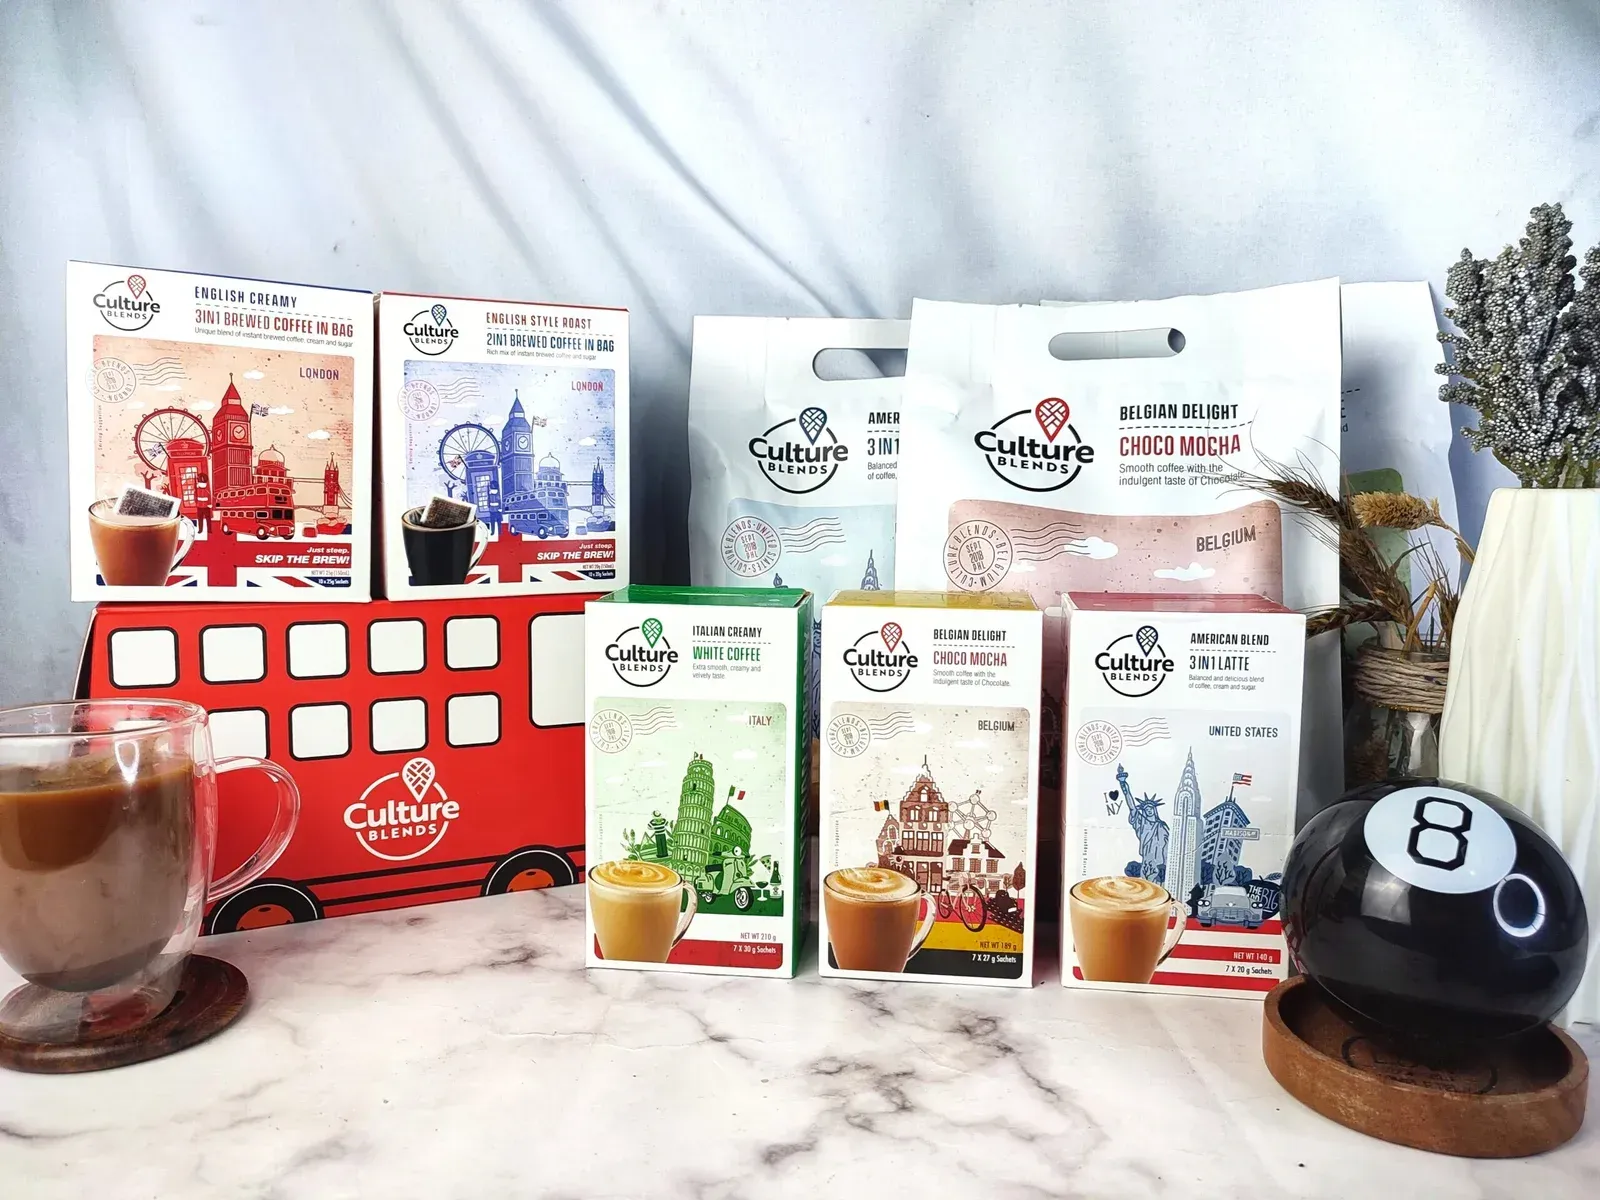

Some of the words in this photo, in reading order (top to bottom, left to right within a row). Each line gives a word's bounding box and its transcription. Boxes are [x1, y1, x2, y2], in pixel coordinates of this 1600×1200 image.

[93, 293, 160, 314] Culture
[195, 286, 244, 303] ENGLISH
[250, 292, 297, 308] CREAMY
[106, 310, 148, 320] BLENDS
[486, 312, 526, 326] ENGLISH
[531, 315, 558, 328] STYLE
[563, 317, 592, 329] ROAST
[196, 309, 220, 324] 3IN1
[224, 312, 270, 330] BREWED
[274, 316, 312, 334] COFFEE
[316, 321, 328, 336] IN
[332, 323, 354, 338] BAG
[403, 322, 459, 338] Culture
[194, 327, 216, 336] Unique
[217, 328, 234, 336] blend
[264, 333, 285, 342] brewed
[415, 337, 448, 346] BLENDS
[486, 332, 507, 346] 2IN1
[510, 334, 547, 349] BREWED
[550, 336, 581, 350] COFFEE
[585, 338, 594, 351] IN
[597, 339, 614, 352] BAG
[300, 367, 339, 380] LONDON
[572, 380, 604, 392] LONDON
[1120, 404, 1178, 420] BELGIAN
[1182, 404, 1238, 420] DELIGHT
[749, 437, 848, 463] Culture
[974, 430, 1095, 464] Culture
[1120, 435, 1174, 456] CHOCO
[1180, 434, 1241, 456] MOCHA
[768, 463, 828, 475] BLENDS
[868, 461, 898, 470] Balanced
[997, 456, 1070, 475] BLENDS
[1119, 463, 1155, 473] Smooth
[1157, 463, 1184, 473] coffee
[1187, 463, 1206, 473] with
[1208, 463, 1224, 473] the
[868, 472, 874, 480] of
[875, 471, 897, 480] coffee,
[1119, 476, 1162, 487] indulgent
[1164, 476, 1188, 486] taste
[1189, 476, 1198, 486] of
[953, 524, 996, 543] BLENDS
[1196, 525, 1257, 553] BELGIUM
[966, 541, 981, 554] SEPT
[255, 554, 283, 564] SKIP
[286, 555, 310, 564] THE
[312, 556, 350, 564] BREW!
[537, 551, 560, 560] SKIP
[562, 551, 581, 560] THE
[584, 551, 614, 559] BREW!
[969, 550, 984, 564] 2018
[693, 625, 725, 637] ITALIAN
[728, 626, 762, 638] CREAMY
[933, 629, 969, 640] BELGIAN
[972, 630, 1006, 641] DELIGHT
[1190, 633, 1238, 645] AMERICAN
[1241, 634, 1269, 646] BLEND
[605, 643, 678, 663] Culture
[693, 646, 724, 660] WHITE
[727, 647, 761, 661] COFFEE
[843, 648, 918, 668] Culture
[933, 651, 967, 666] CHOCO
[970, 652, 1007, 666] MOCHA
[620, 664, 663, 672] BLENDS
[1095, 652, 1175, 673] Culture
[1219, 656, 1250, 671] LATTE
[858, 668, 903, 677] BLENDS
[1111, 673, 1158, 682] BLENDS
[933, 678, 959, 686] indulgent
[749, 715, 772, 726] ITALY
[978, 720, 1015, 731] BELGIUM
[1209, 725, 1241, 737] UNITED
[1244, 727, 1278, 738] STATES
[1103, 792, 1108, 803] I
[343, 800, 460, 829] Culture
[1106, 800, 1123, 816] NY
[368, 824, 437, 841] BLENDS
[1406, 796, 1473, 871] 8
[1249, 884, 1263, 895] THE
[1260, 888, 1281, 910] BIG
[757, 945, 776, 954] Sachets
[1233, 952, 1245, 960] NET
[996, 955, 1016, 963] Sachets
